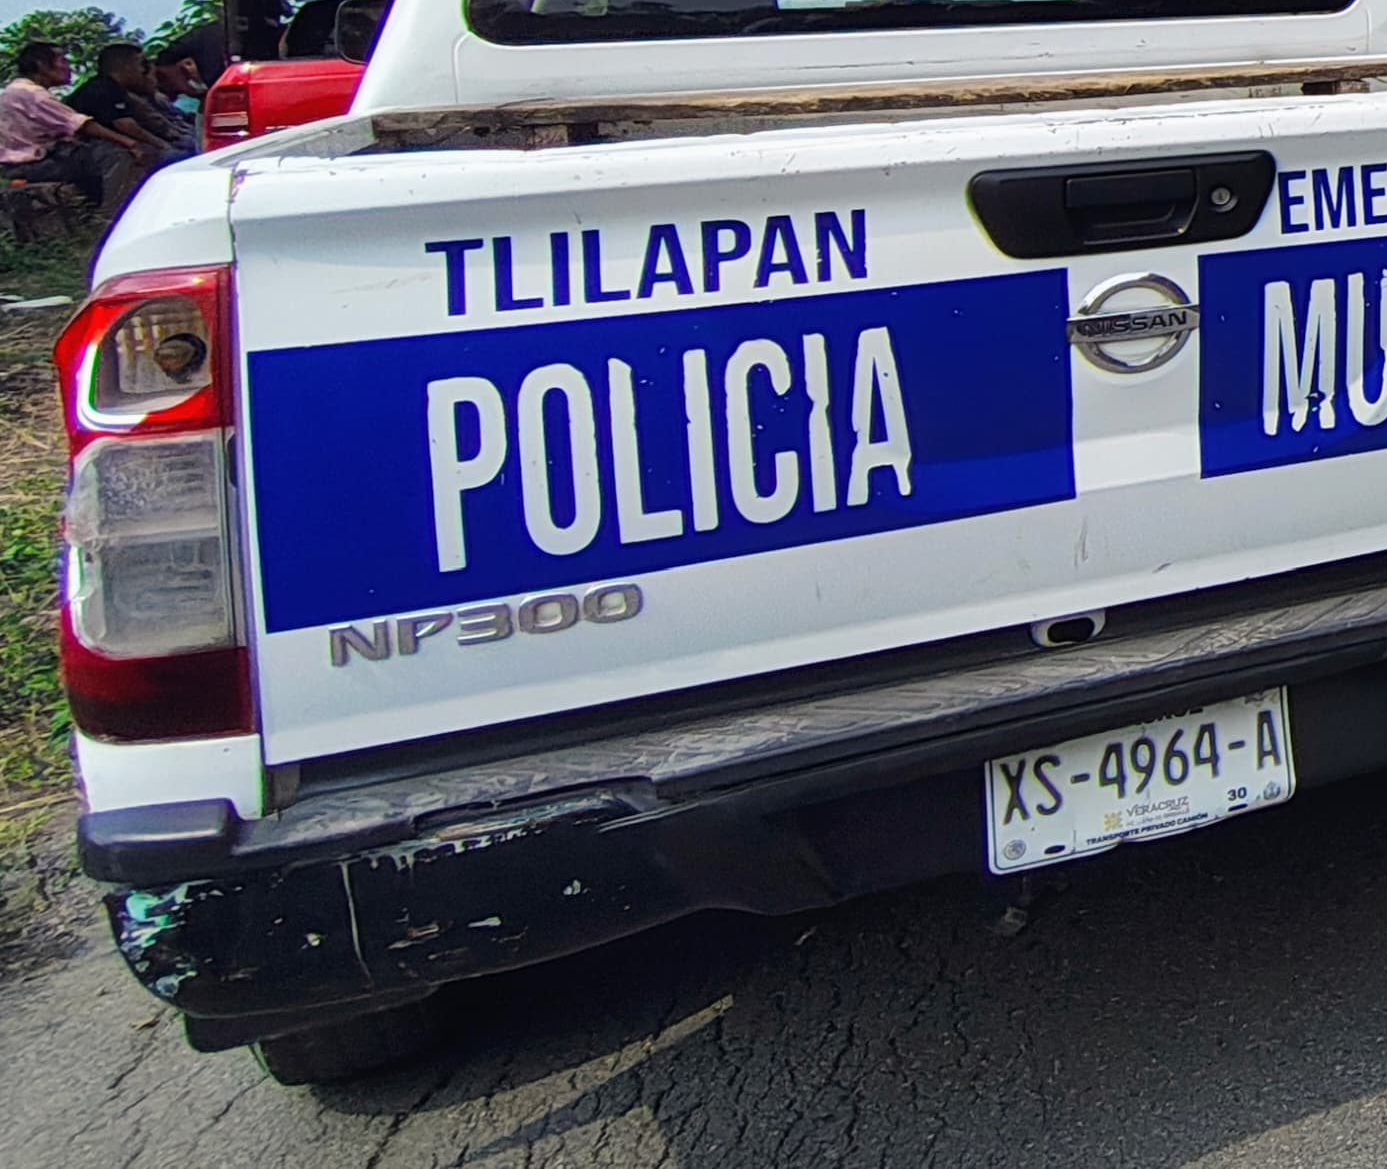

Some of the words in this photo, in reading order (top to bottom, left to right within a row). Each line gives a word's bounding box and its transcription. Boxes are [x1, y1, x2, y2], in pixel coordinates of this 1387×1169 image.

[425, 209, 867, 316] TLILAPAN
[1077, 311, 1187, 337] NISSAN
[427, 326, 912, 572] POLICIA
[329, 583, 643, 666] NP300
[1000, 710, 1281, 825] XS-4964-A
[1126, 796, 1190, 817] VERACRUZ
[1227, 787, 1247, 801] 30
